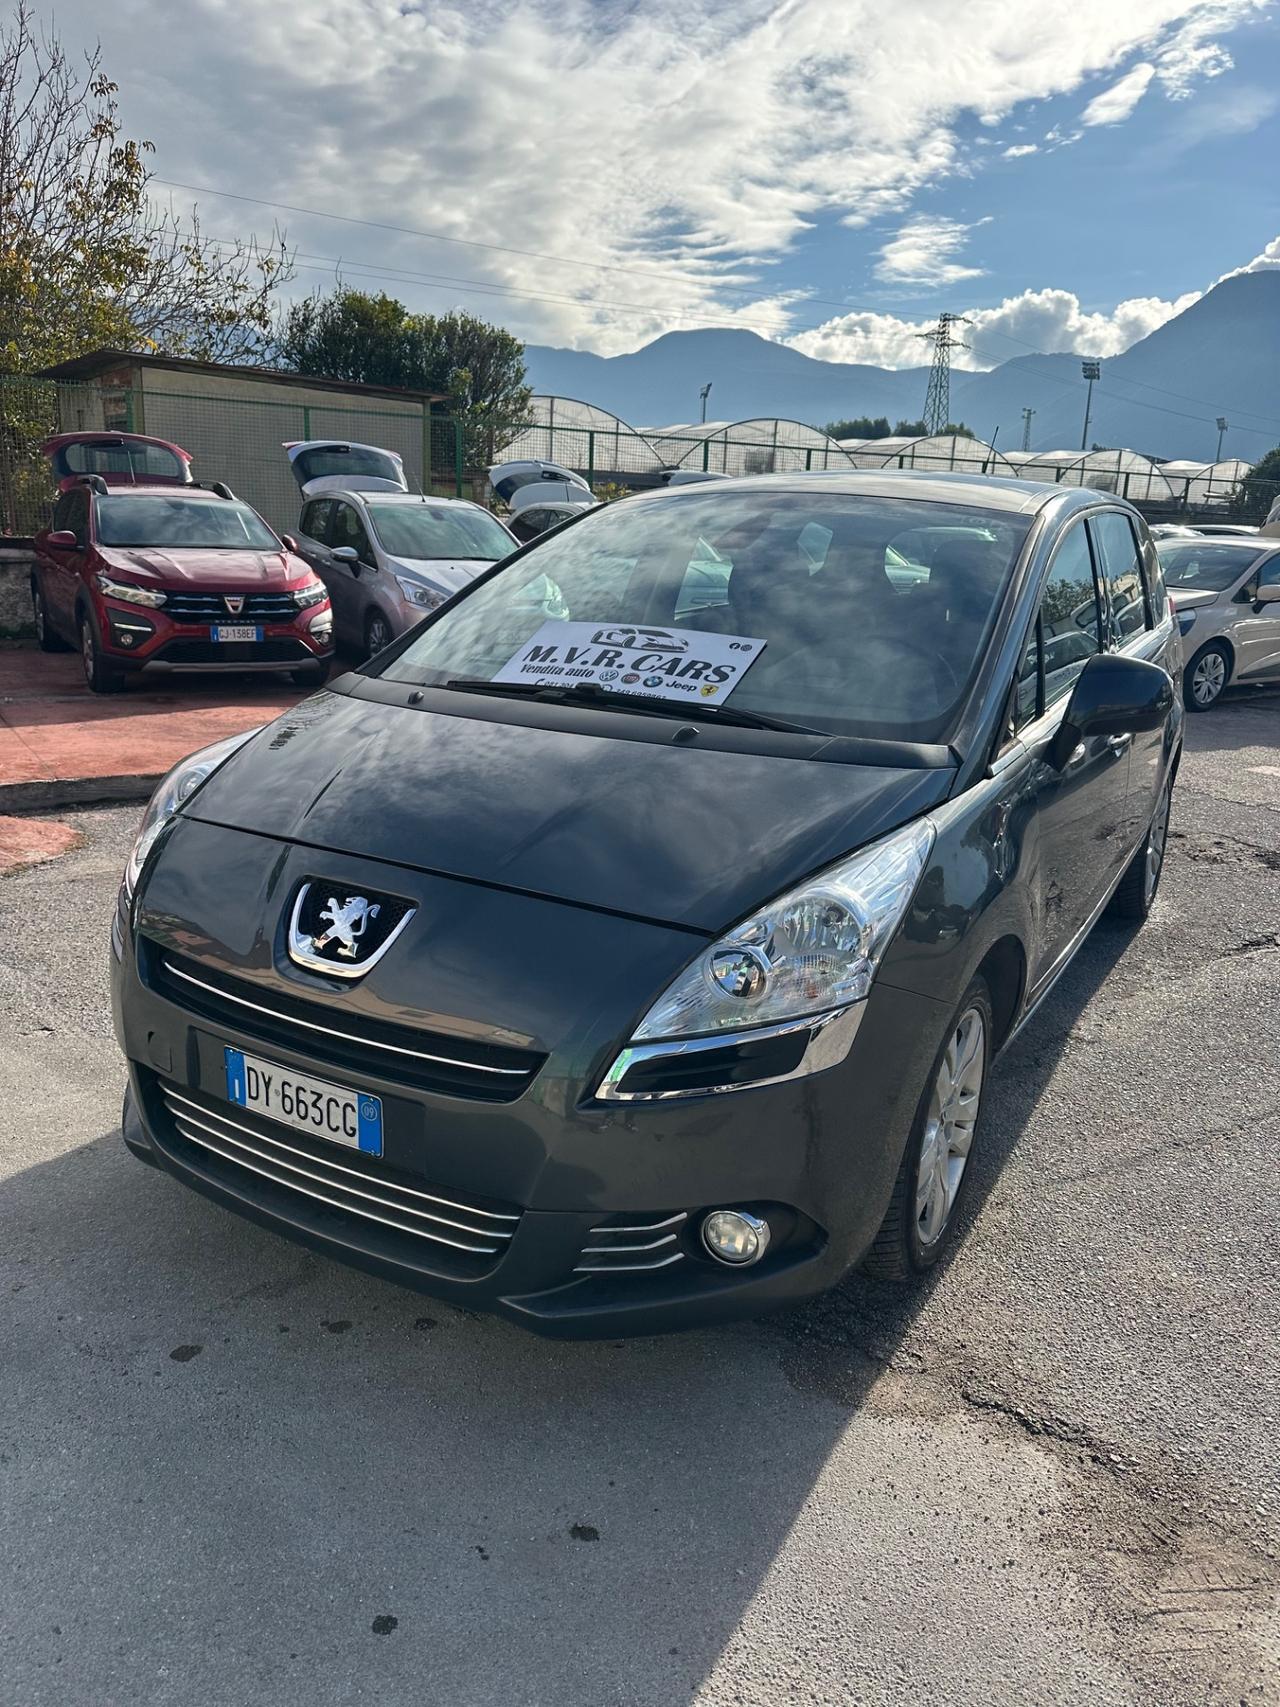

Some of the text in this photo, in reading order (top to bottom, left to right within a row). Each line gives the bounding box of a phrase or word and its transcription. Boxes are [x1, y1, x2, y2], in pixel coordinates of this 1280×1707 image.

[520, 664, 595, 678] Vendita auto
[522, 645, 736, 683] M.V.R. CARS
[665, 680, 697, 692] Jeep
[246, 1065, 273, 1107] DY
[281, 1080, 357, 1138] 663CG
